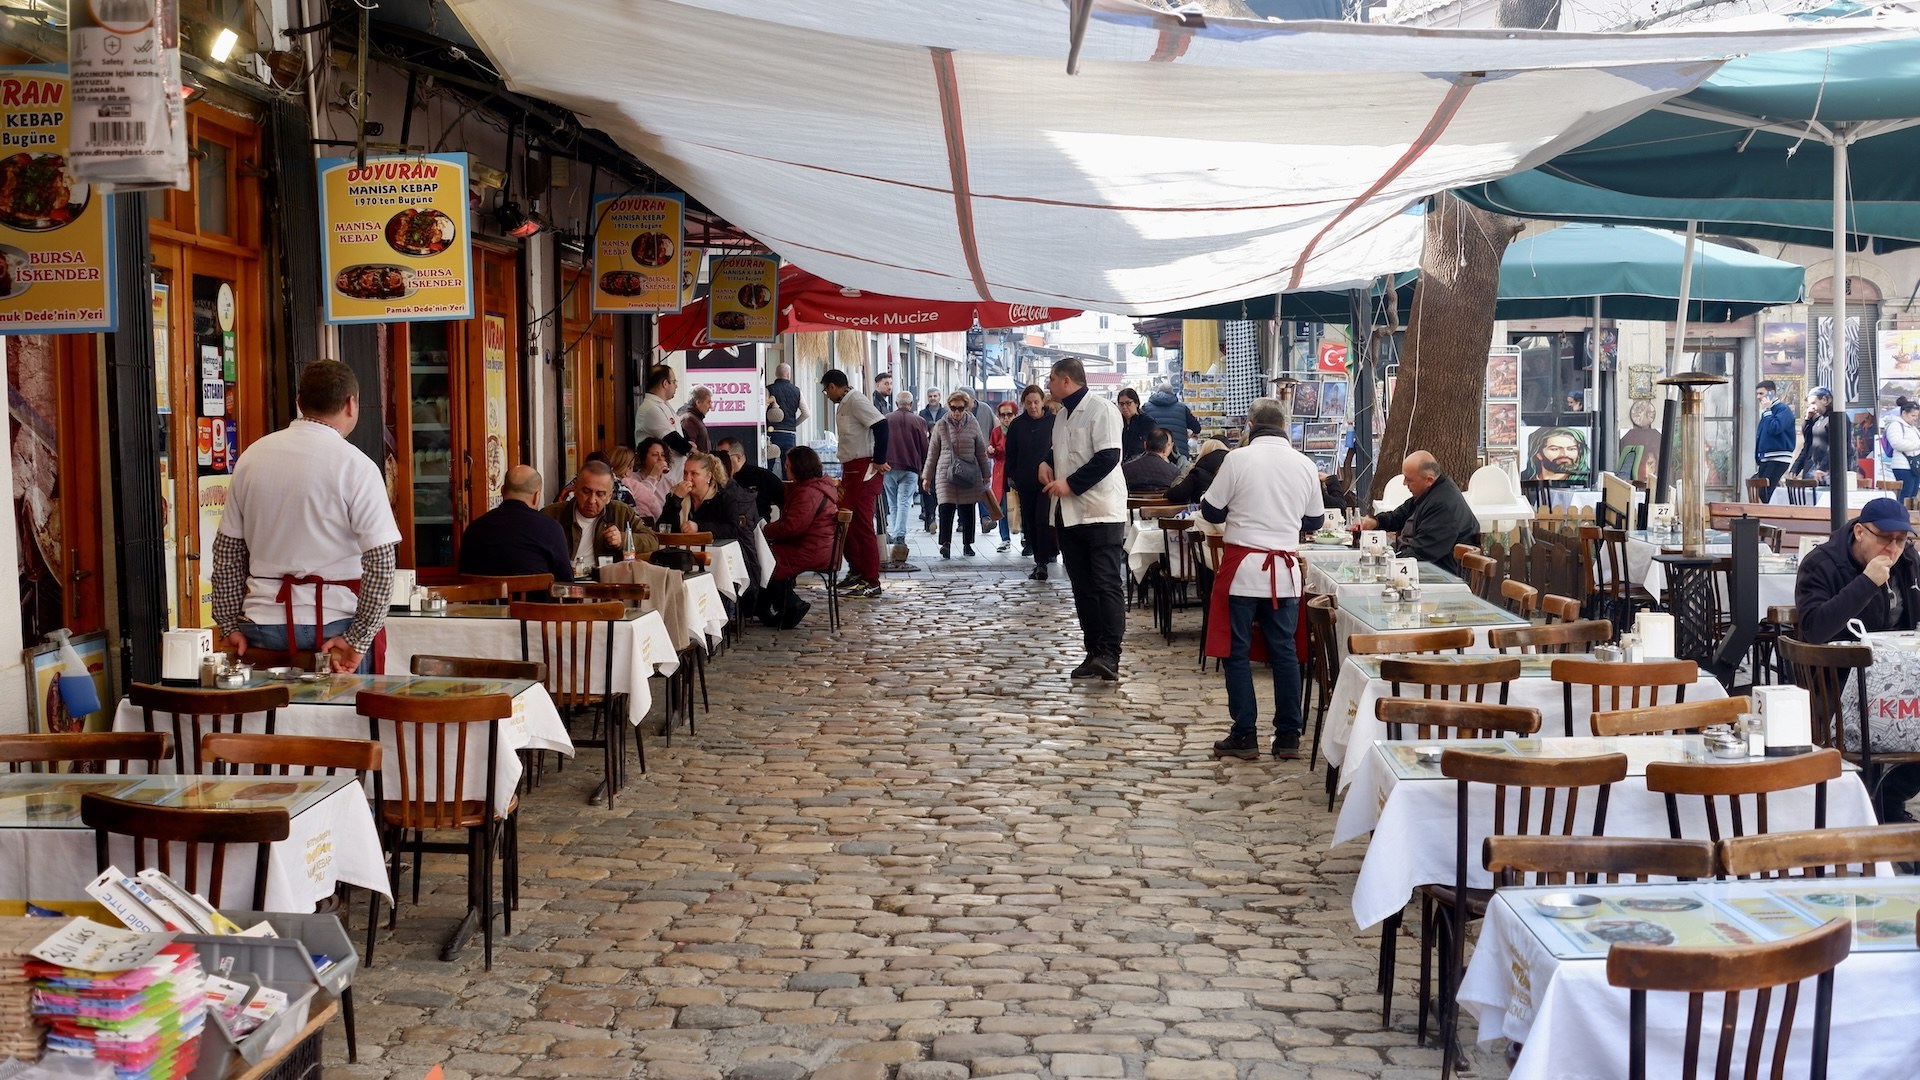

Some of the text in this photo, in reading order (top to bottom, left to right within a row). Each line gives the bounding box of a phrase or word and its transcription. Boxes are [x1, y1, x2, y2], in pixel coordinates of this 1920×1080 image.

[0, 80, 63, 106] RAN
[7, 113, 63, 127] KEBAP
[3, 132, 55, 147] Bugüne
[70, 148, 164, 157] www.diremplast.com
[348, 163, 438, 181] DOYURAN
[350, 183, 438, 195] MANİSA KEBAP
[399, 196, 433, 205] Bugüne
[610, 199, 666, 212] DOYURAN
[335, 221, 381, 232] MANİSA
[340, 234, 378, 243] KEBAP
[30, 252, 85, 264] BURSA
[723, 259, 765, 269] DOYURAN
[16, 268, 99, 282] İSKENDER
[417, 269, 452, 277] BURSA
[450, 304, 465, 312] Yeri
[25, 310, 75, 321] Dede'nin
[80, 309, 102, 320] Yeri
[823, 310, 939, 326] Gerçek Mucize
[692, 382, 751, 394] EKOR
[711, 398, 745, 411] VİZE
[1658, 507, 1669, 516] 27
[1371, 536, 1378, 544] 5
[1400, 566, 1408, 575] 4
[201, 639, 210, 653] 12
[1757, 699, 1763, 714] 2
